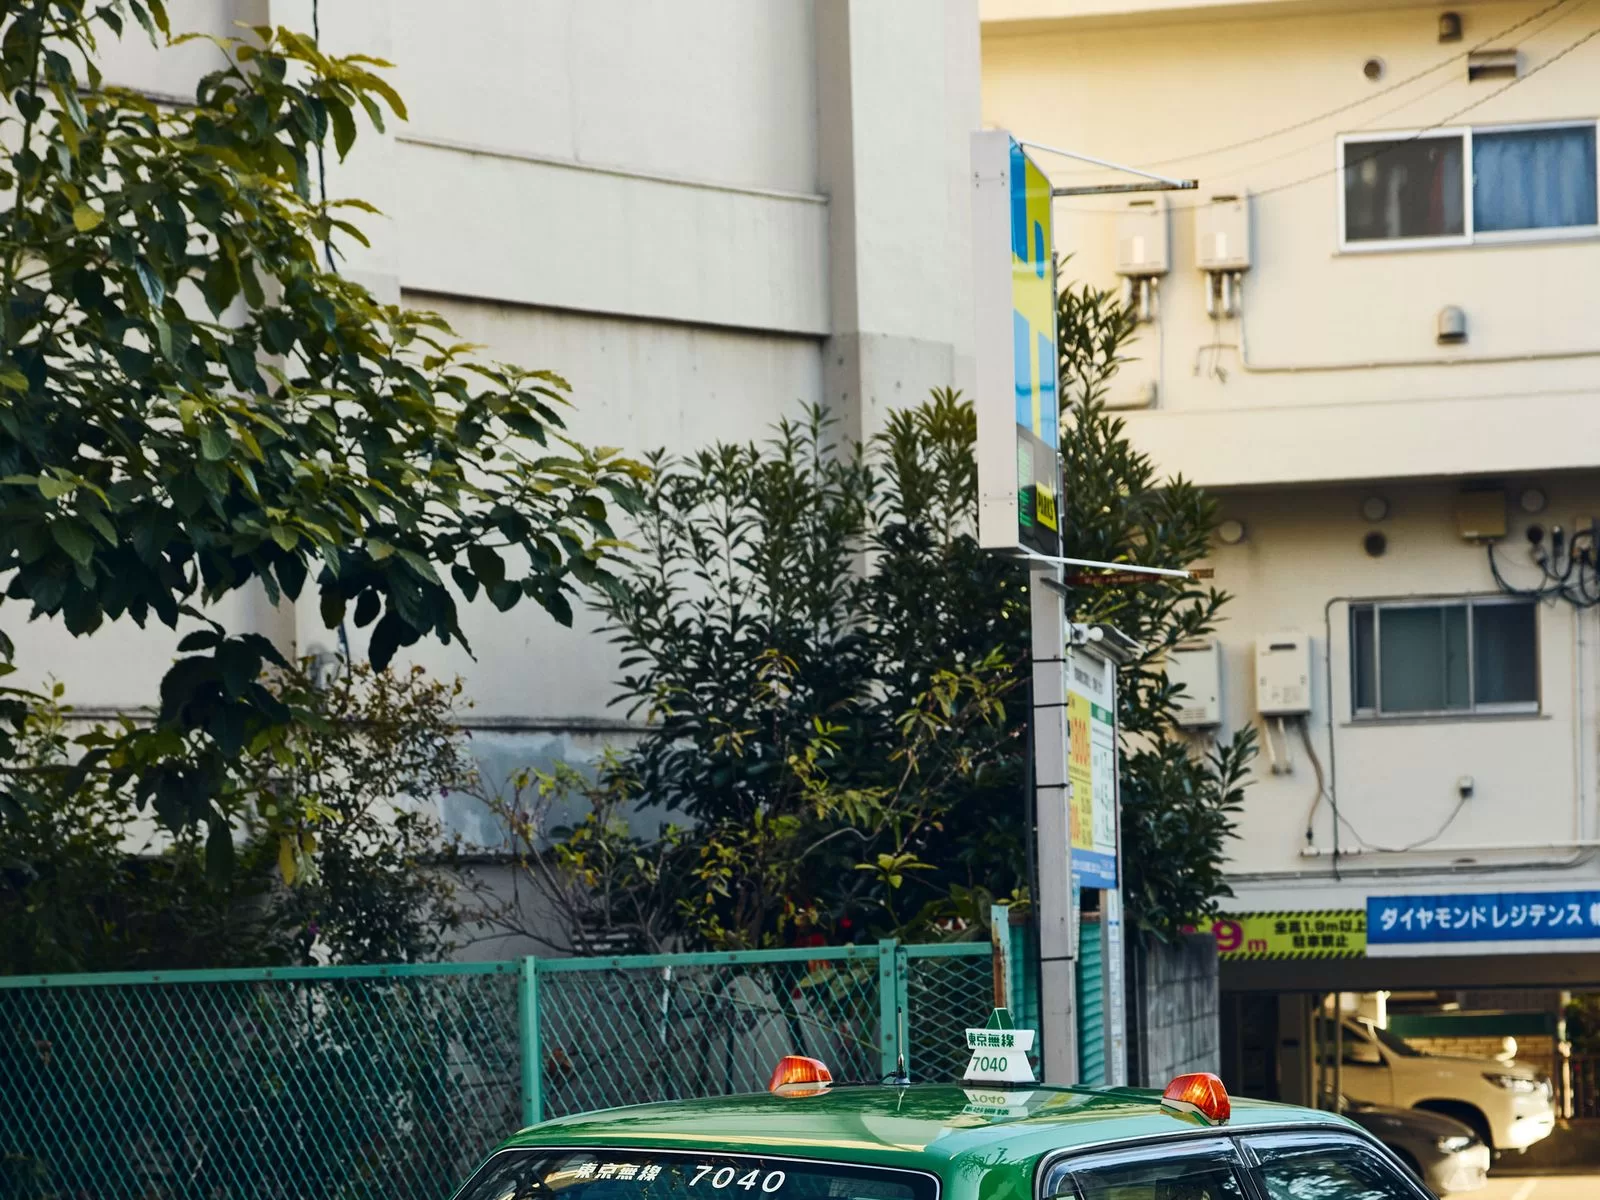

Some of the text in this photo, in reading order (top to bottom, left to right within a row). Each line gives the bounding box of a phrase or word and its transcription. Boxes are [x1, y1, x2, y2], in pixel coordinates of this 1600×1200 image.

[968, 1033, 1015, 1047] 東京無線
[973, 1057, 1007, 1072] 7040
[574, 1162, 786, 1193] 東京無線 7040
